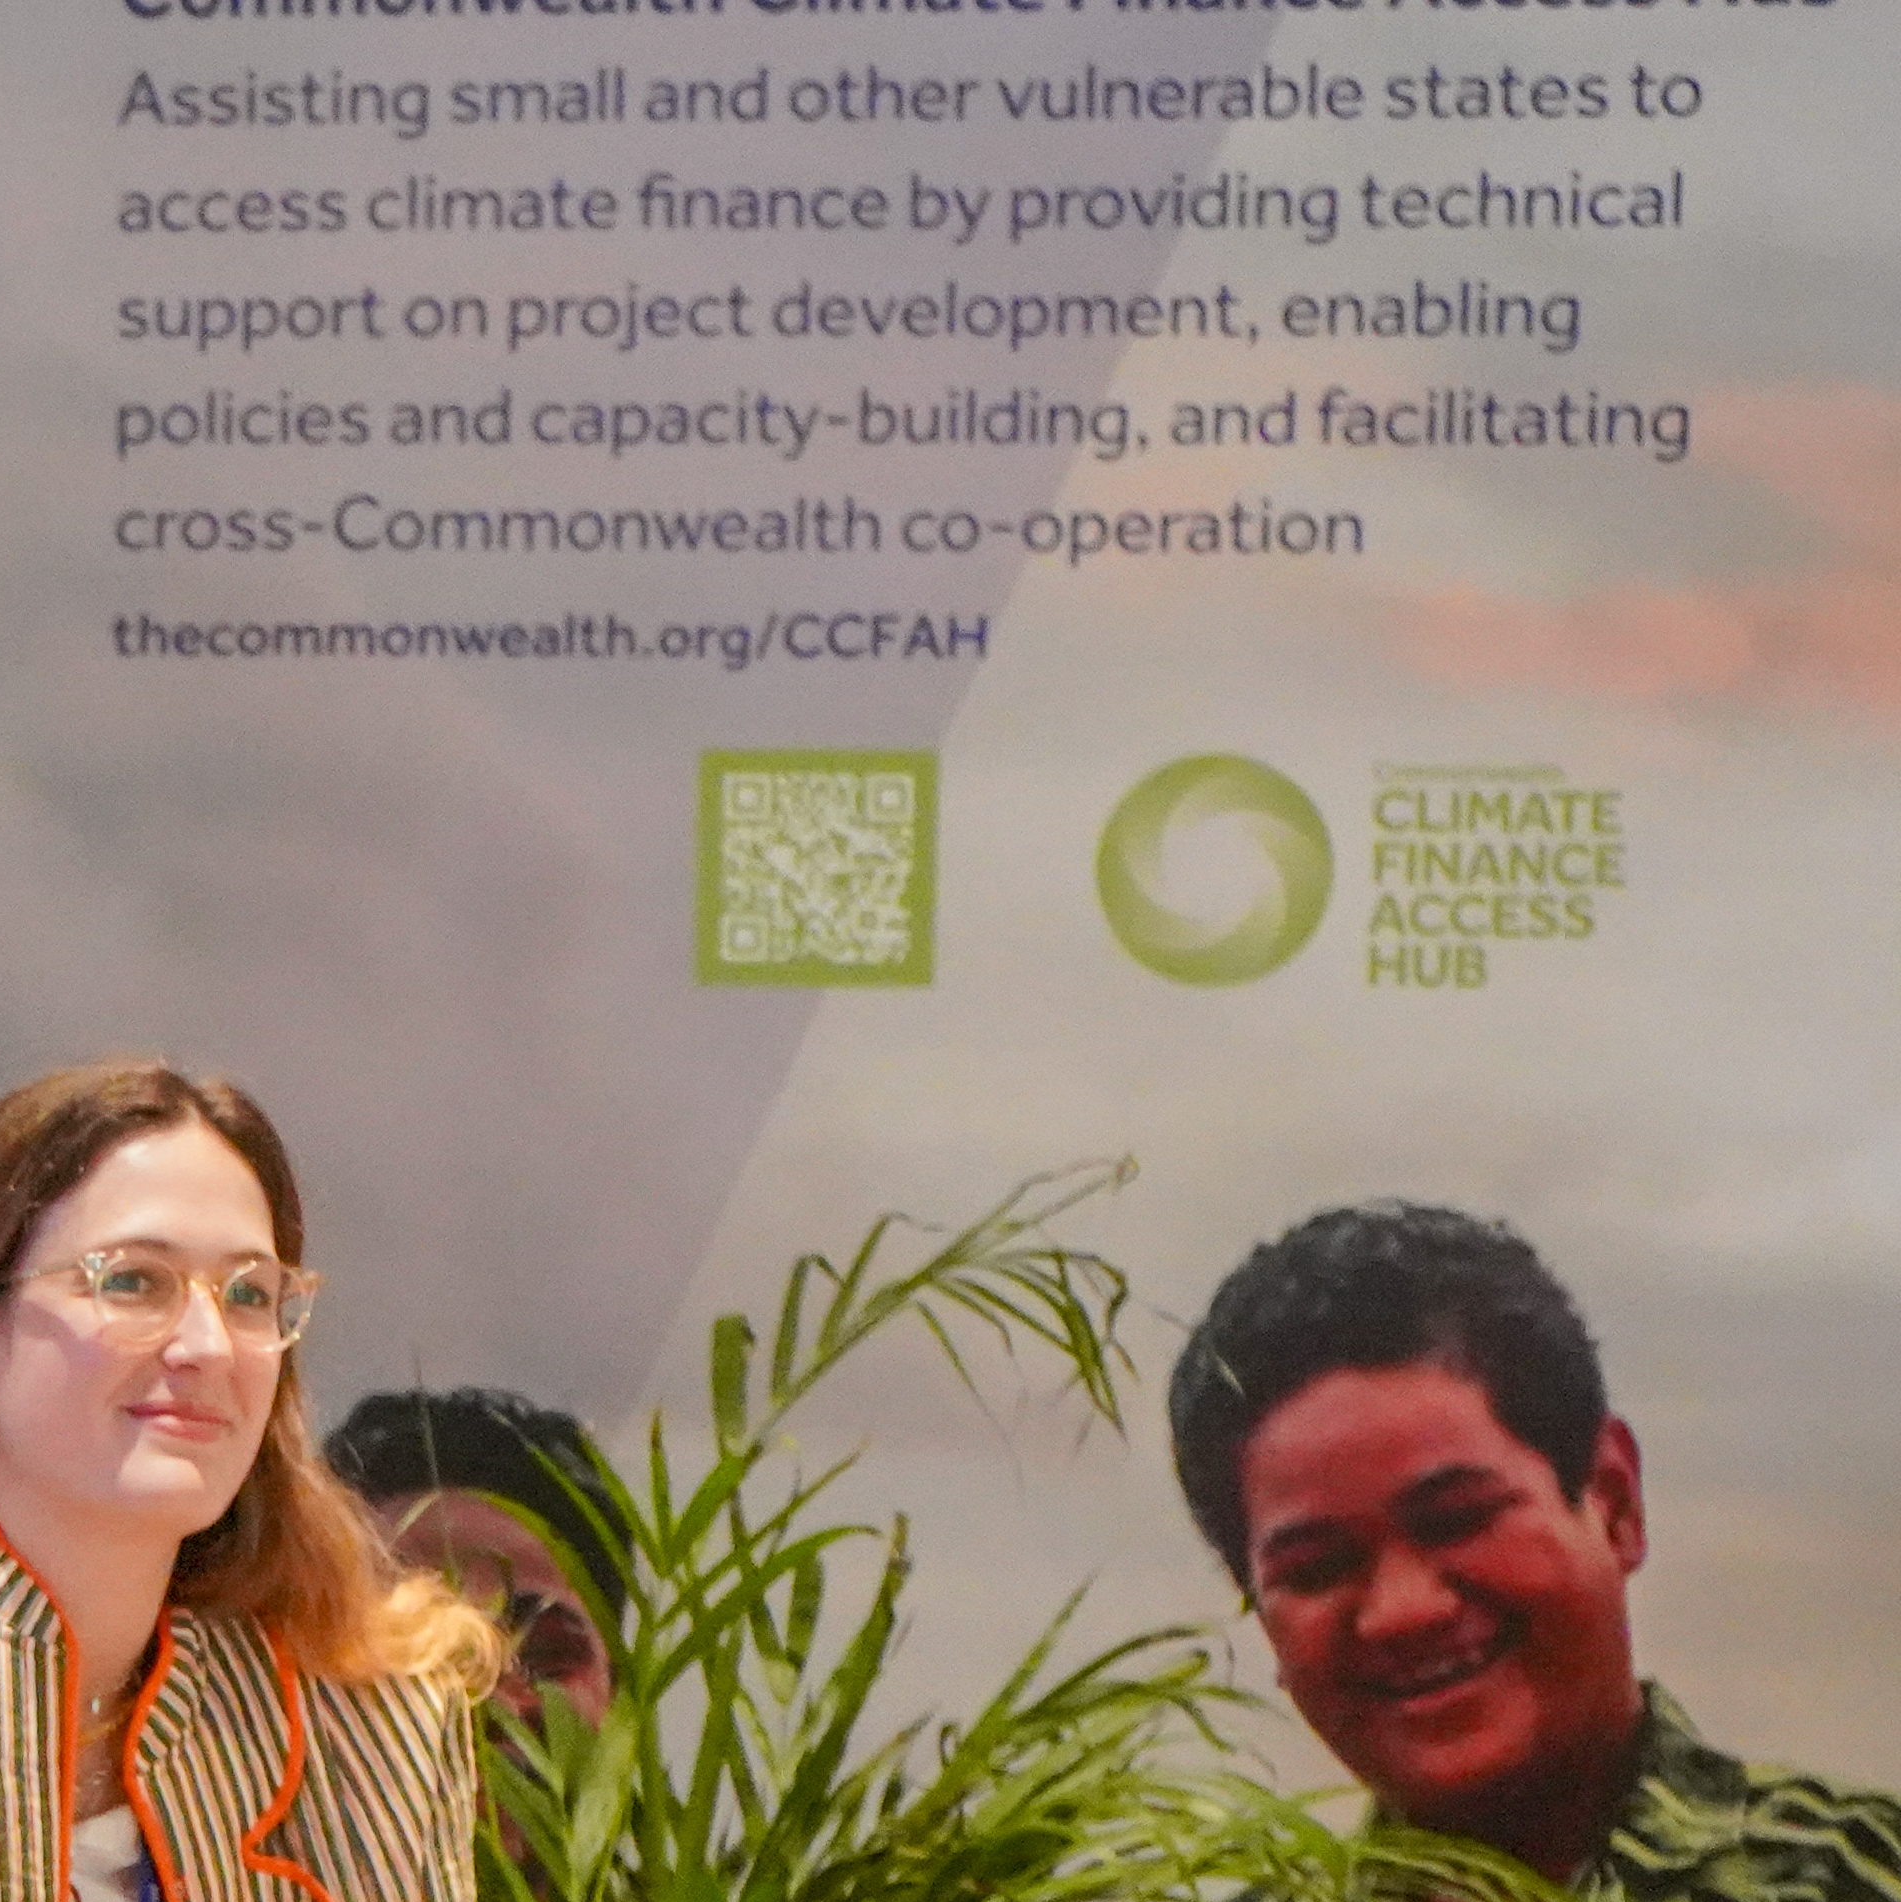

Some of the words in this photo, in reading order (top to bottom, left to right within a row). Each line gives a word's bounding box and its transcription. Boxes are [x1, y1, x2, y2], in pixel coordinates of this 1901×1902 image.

[117, 69, 431, 142] Assisting
[449, 65, 627, 126] small
[642, 66, 771, 124] and
[787, 64, 981, 124] other
[996, 62, 1364, 122] vulnerable
[1384, 64, 1610, 121] states
[1629, 64, 1704, 119] to
[116, 189, 348, 235] access
[365, 174, 620, 233] climate
[636, 170, 891, 232] finance
[908, 172, 992, 247] by
[1008, 172, 1339, 246] providing
[1359, 169, 1684, 230] technical
[117, 286, 385, 354] support
[401, 294, 490, 341] on
[506, 282, 753, 354] project
[770, 279, 1259, 353] development,
[1280, 278, 1582, 356] enabling
[113, 389, 372, 462] policies
[388, 387, 514, 447] and
[528, 387, 1148, 462] capacity-building,
[1169, 389, 1298, 447] and
[1317, 388, 1691, 465] facilitating
[112, 492, 883, 555] cross-Commonwealth
[898, 499, 1365, 568] co-operation
[109, 611, 989, 672] thecommonwealth.org/CCFAH
[1371, 788, 1625, 838] CLIMATE
[1372, 840, 1627, 889] FINANCE
[1366, 892, 1596, 941] ACCESS
[1363, 944, 1489, 990] HUB
